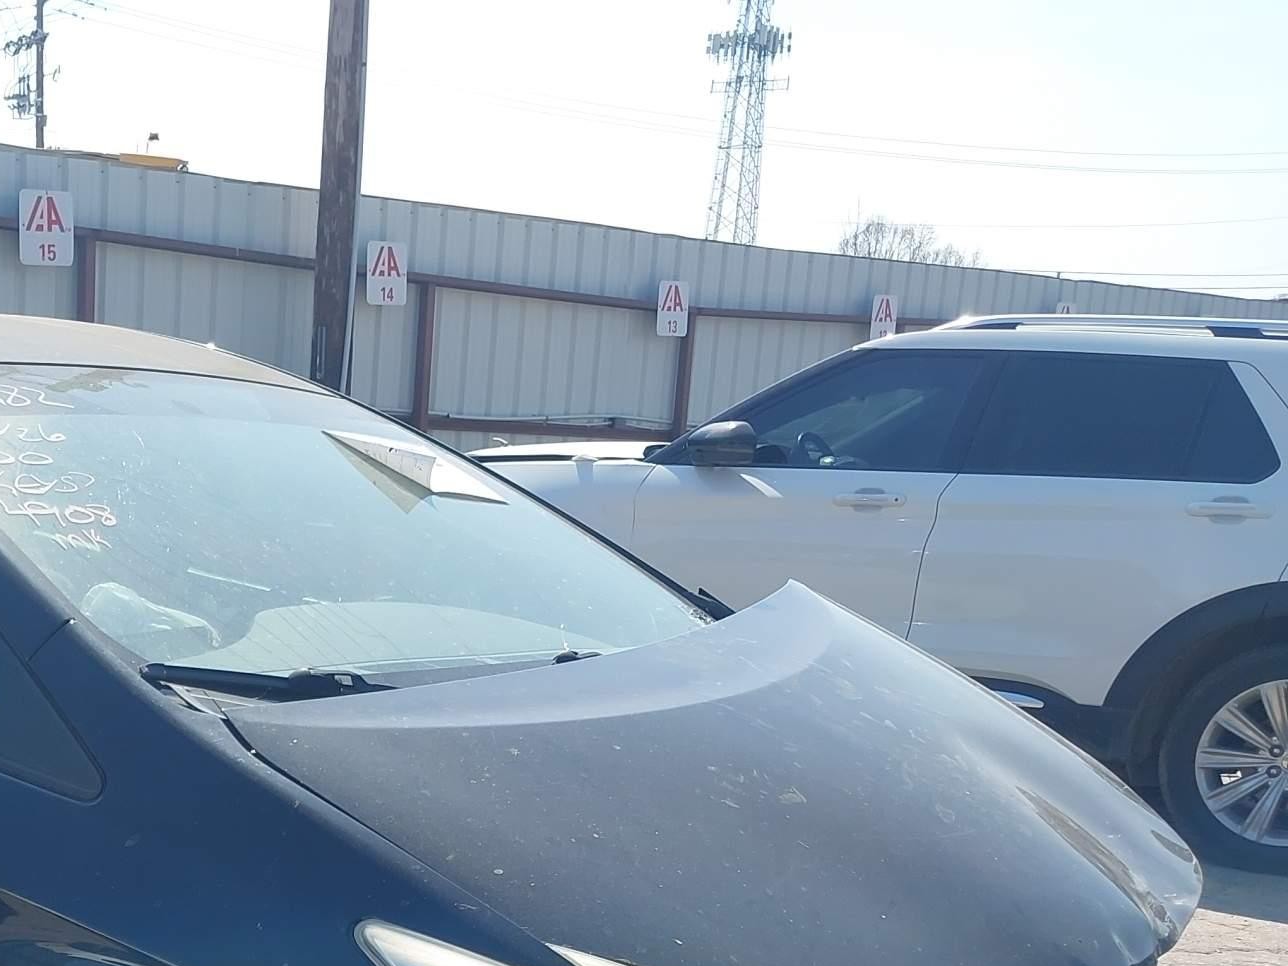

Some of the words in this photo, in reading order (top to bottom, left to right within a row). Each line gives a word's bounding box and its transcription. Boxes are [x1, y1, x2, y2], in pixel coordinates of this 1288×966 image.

[39, 244, 57, 262] 15
[380, 287, 395, 302] 14
[667, 320, 678, 334] 13
